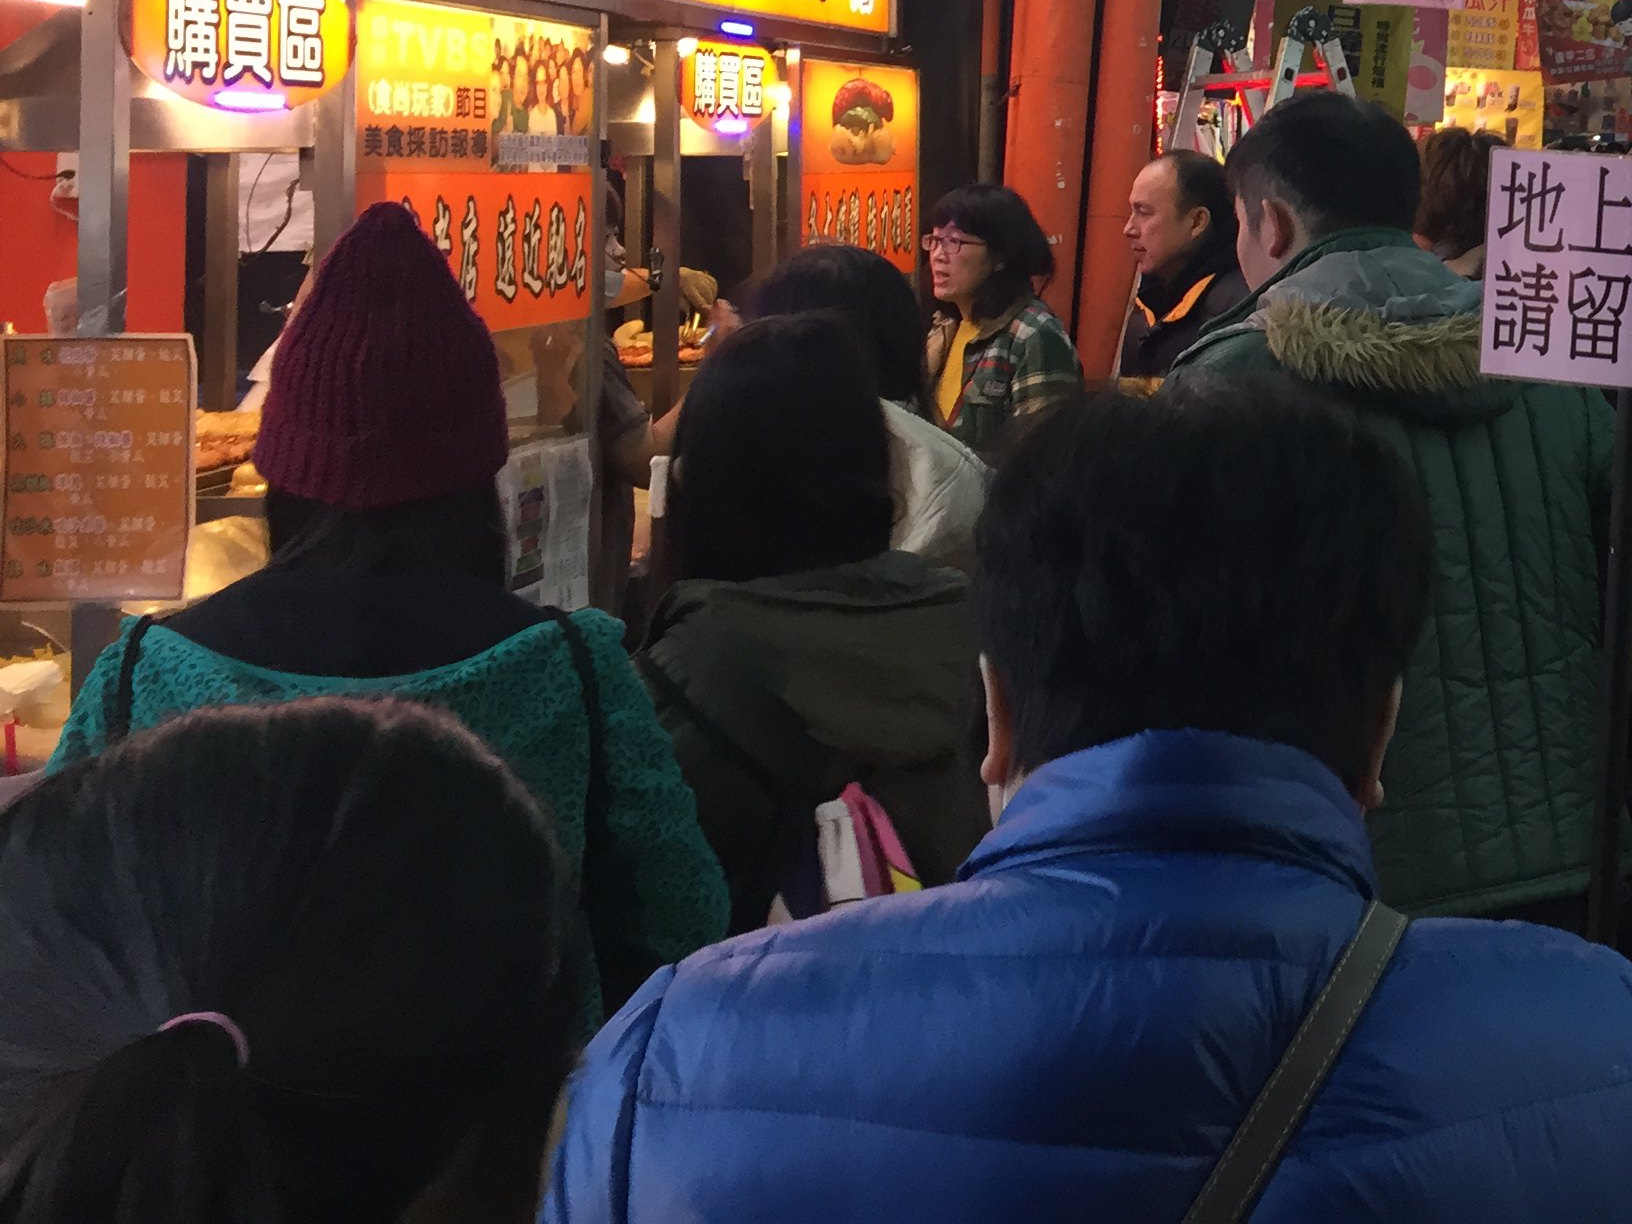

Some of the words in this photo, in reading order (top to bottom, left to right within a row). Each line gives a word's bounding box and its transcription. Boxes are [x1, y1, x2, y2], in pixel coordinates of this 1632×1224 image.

[391, 21, 489, 75] TVBS
[694, 47, 765, 119] 購買區
[363, 125, 488, 159] 美食採訪報導
[402, 195, 479, 303] 老店
[496, 194, 586, 304] 遠近馳名
